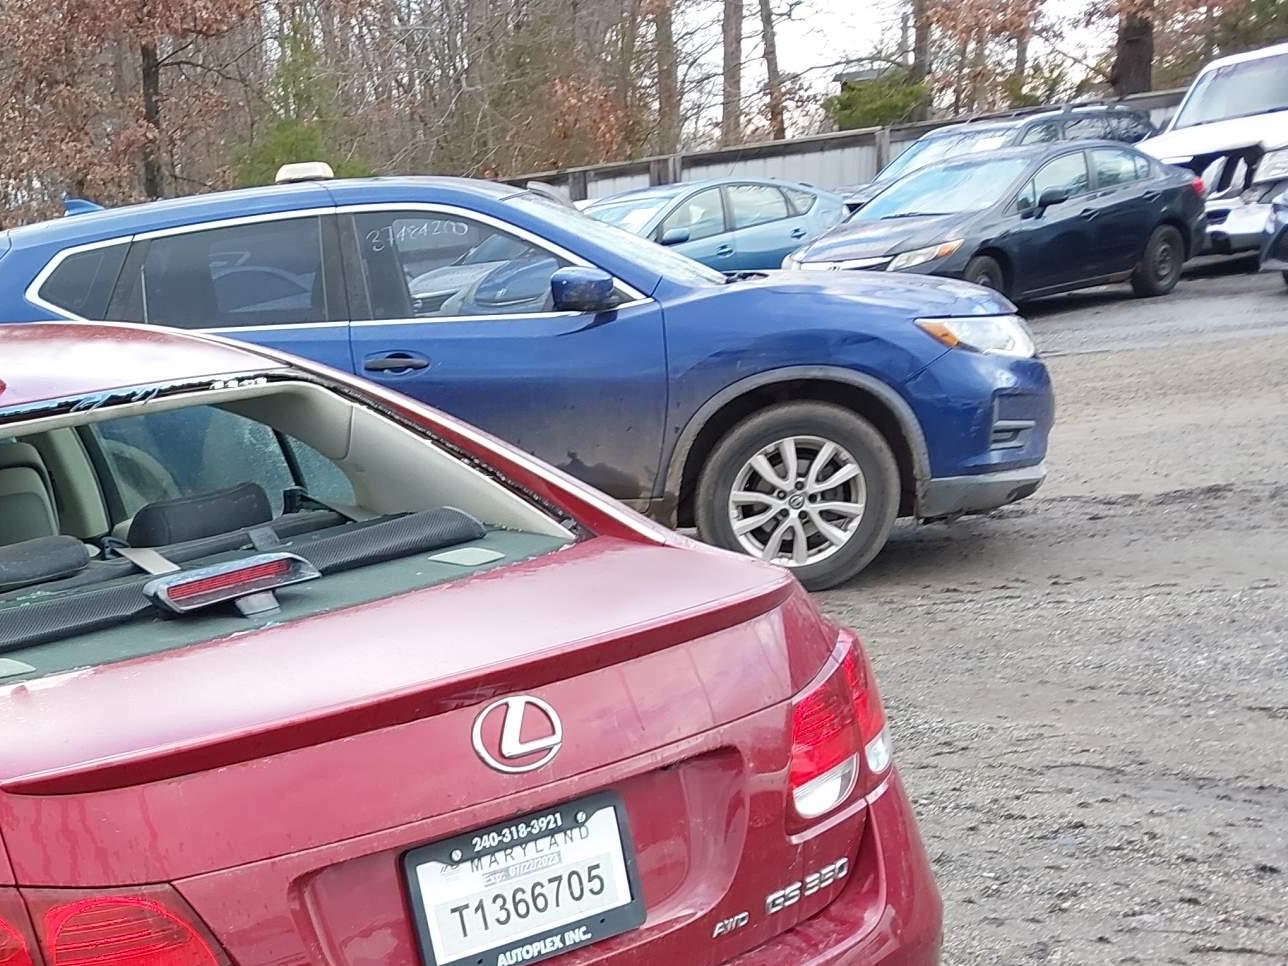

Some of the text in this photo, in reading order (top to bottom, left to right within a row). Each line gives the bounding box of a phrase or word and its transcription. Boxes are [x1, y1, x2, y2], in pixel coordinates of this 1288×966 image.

[469, 824, 590, 874] MARYLAND
[472, 812, 562, 852] 240-318-3921
[450, 863, 605, 938] T1366705
[712, 857, 849, 939] AWD GS 350
[563, 926, 592, 948] INC.
